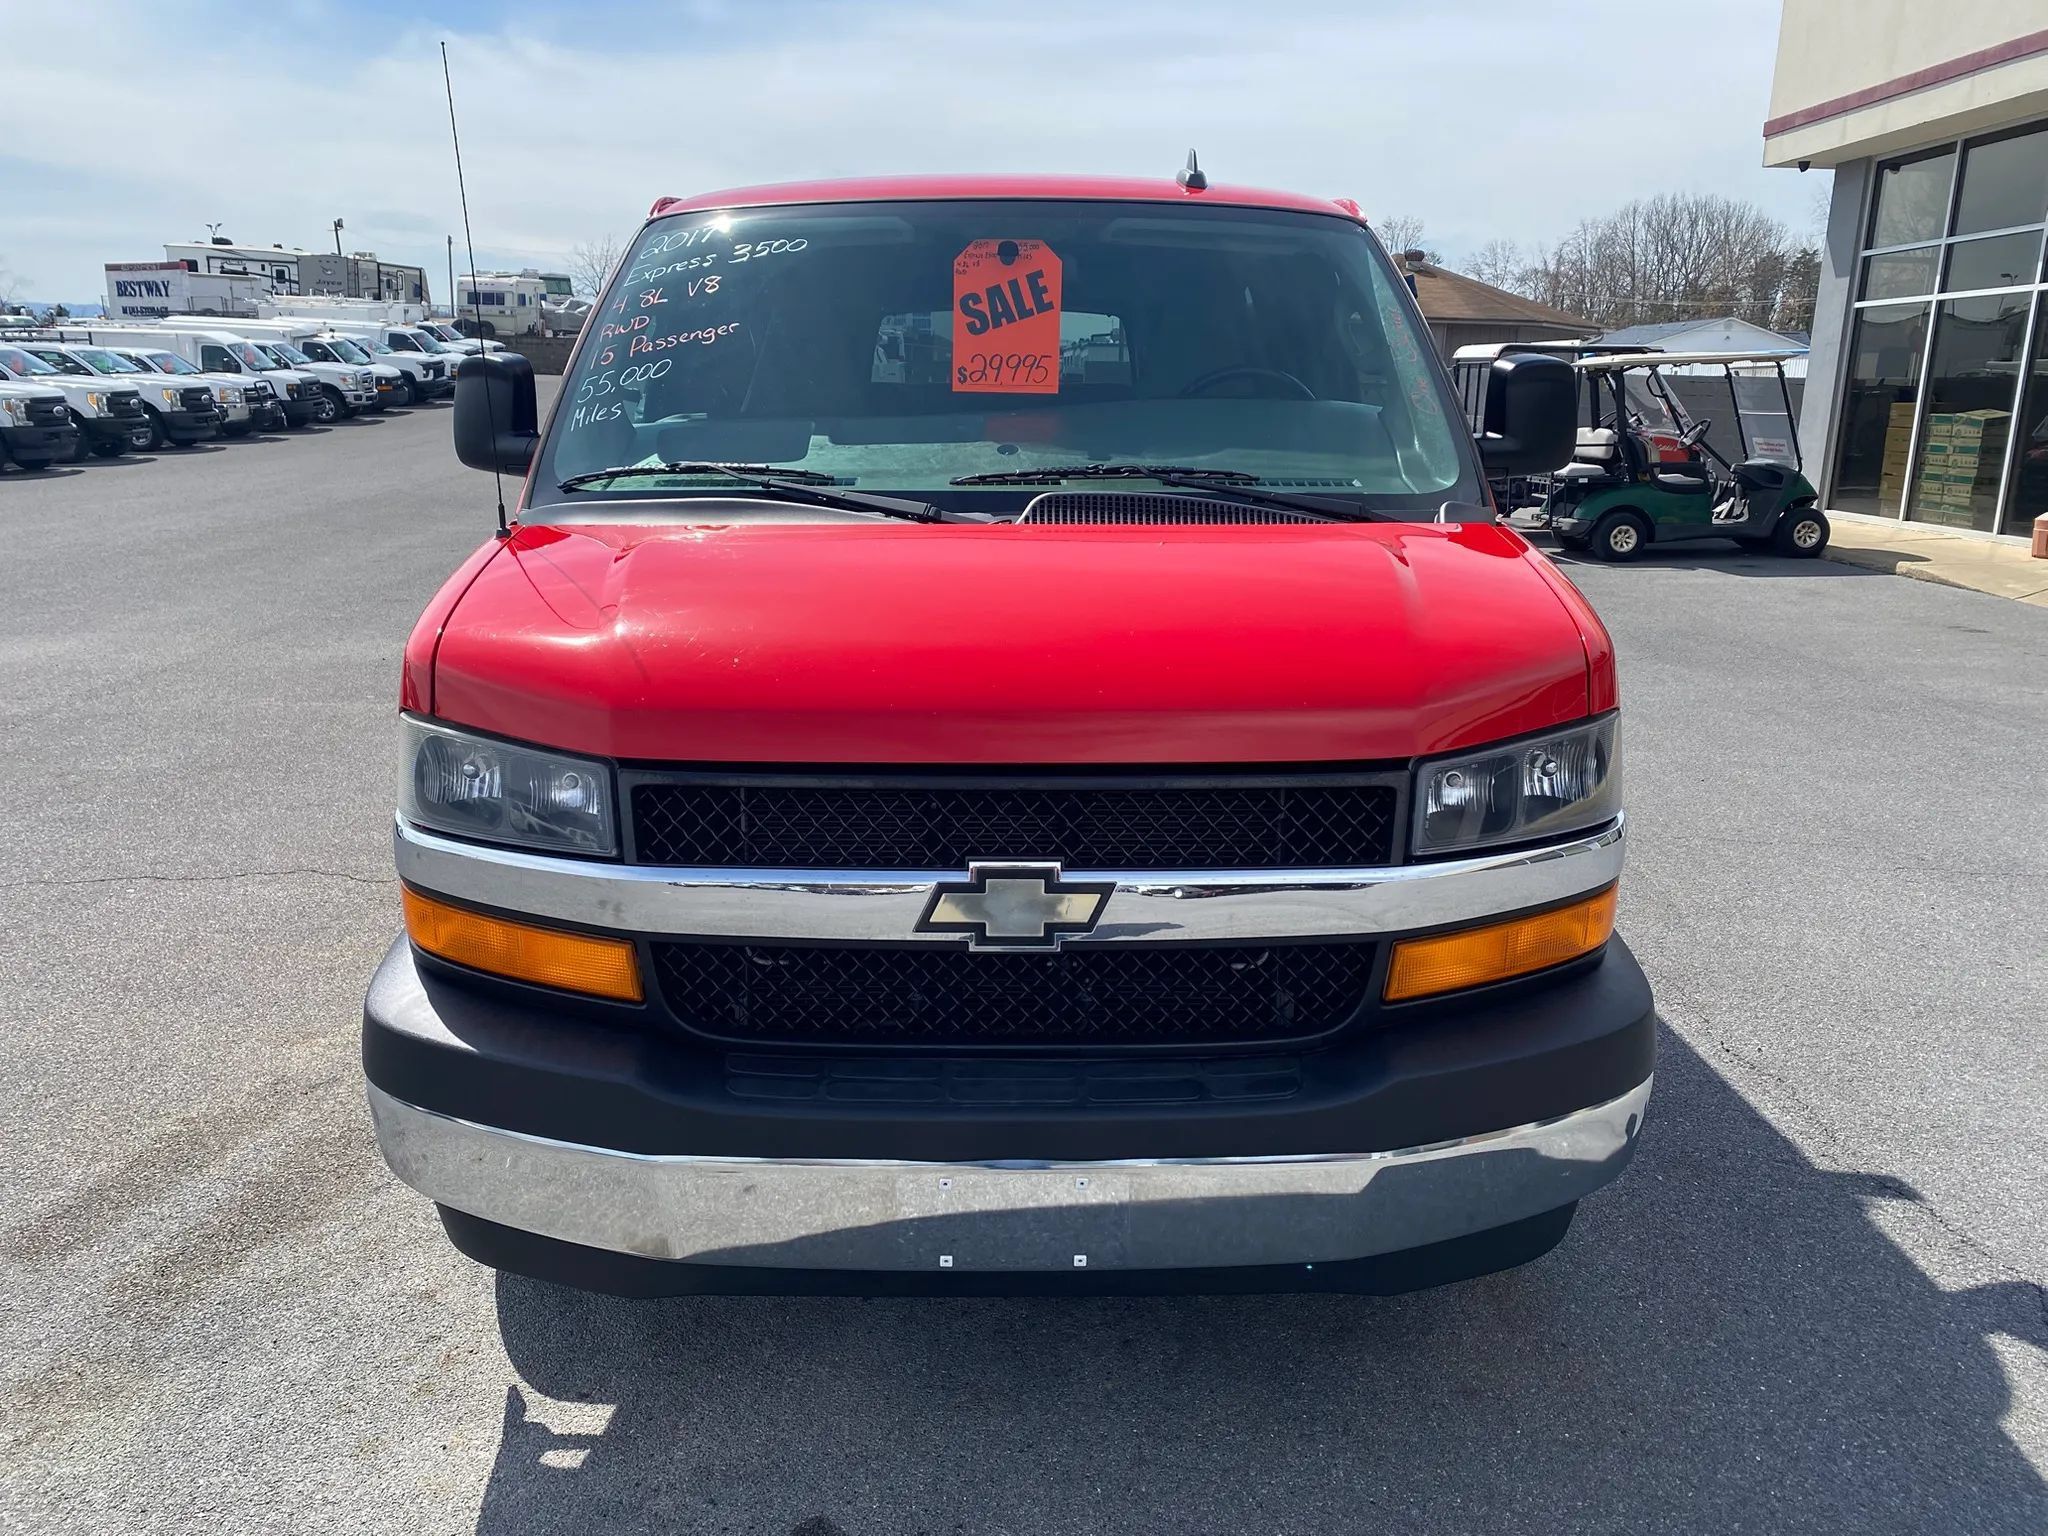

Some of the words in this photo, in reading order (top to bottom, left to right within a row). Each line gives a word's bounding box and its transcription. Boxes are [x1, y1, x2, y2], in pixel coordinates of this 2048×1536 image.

[640, 226, 718, 260] 2017
[624, 252, 717, 287] Express
[728, 238, 808, 264] 3500
[115, 280, 170, 297] BESTWAY
[688, 275, 722, 297] V8
[959, 269, 1055, 336] SALE
[590, 344, 615, 370] 15
[629, 321, 740, 358] Passenger
[599, 315, 650, 343] RWD
[577, 359, 673, 404] 55,000
[570, 401, 622, 432] Miles
